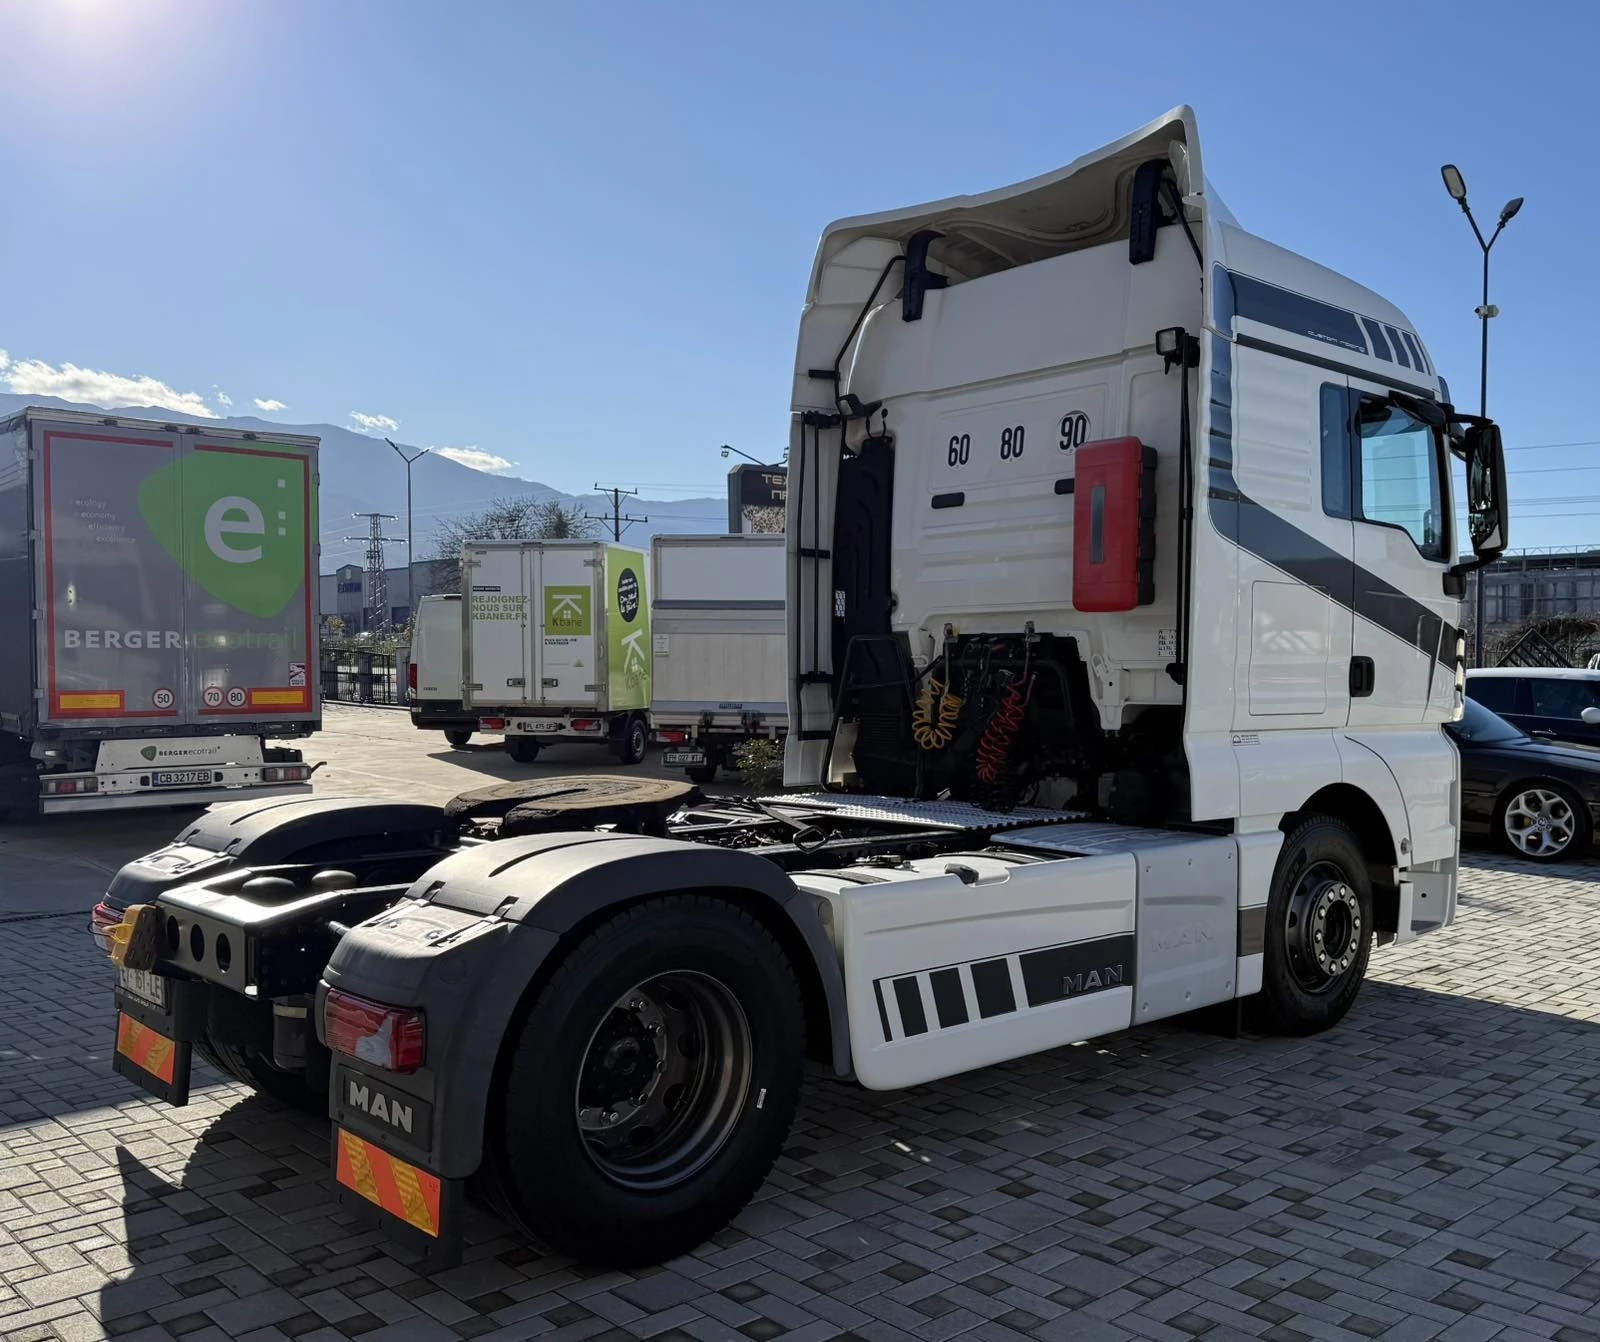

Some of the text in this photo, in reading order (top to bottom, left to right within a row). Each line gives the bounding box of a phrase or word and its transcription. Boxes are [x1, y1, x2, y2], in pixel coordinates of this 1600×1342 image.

[948, 415, 1087, 467] 60 80 90
[472, 604, 524, 612] NOUS SUR
[472, 612, 528, 621] KBANER.FR
[64, 629, 182, 649] BERGER
[157, 693, 170, 704] 50
[208, 692, 220, 702] 70
[231, 692, 243, 702] 80
[1151, 924, 1213, 952] MAN
[1063, 964, 1123, 995] MAN
[349, 1080, 413, 1134] MAN
